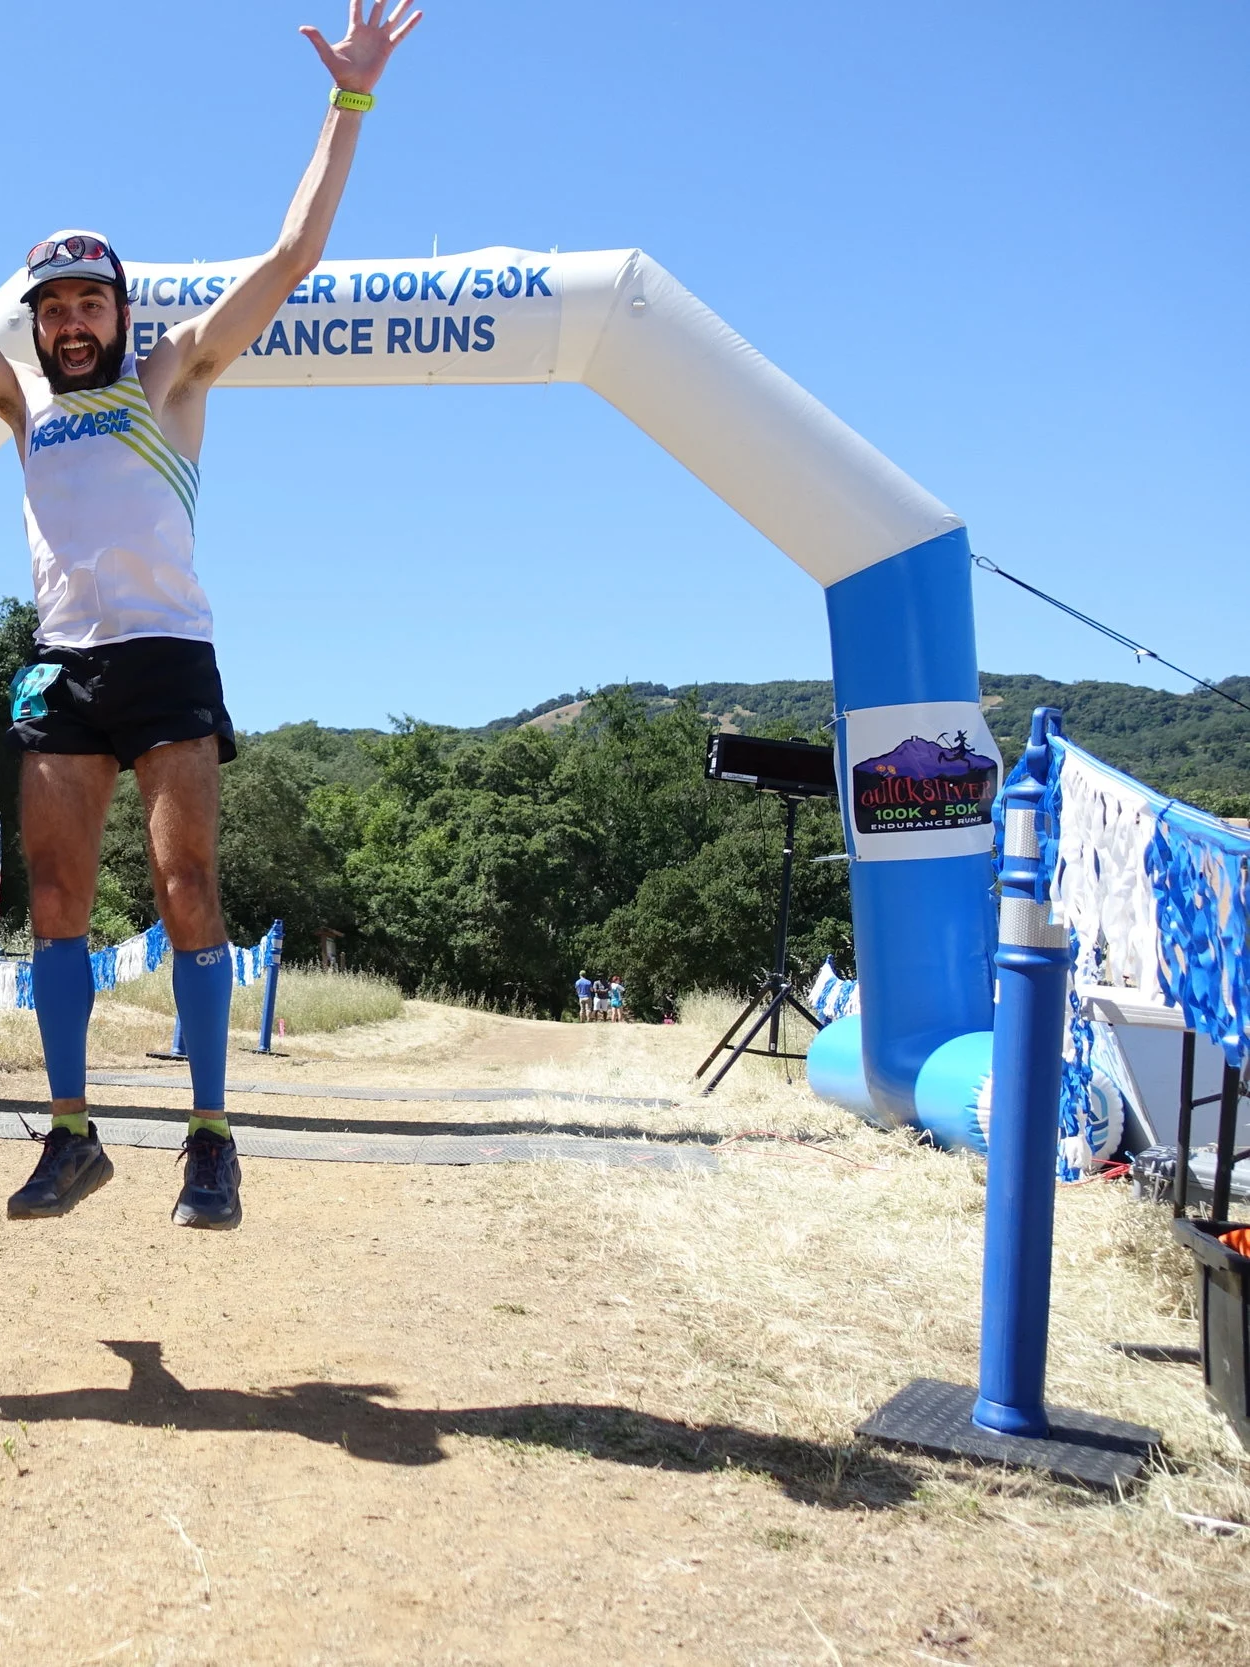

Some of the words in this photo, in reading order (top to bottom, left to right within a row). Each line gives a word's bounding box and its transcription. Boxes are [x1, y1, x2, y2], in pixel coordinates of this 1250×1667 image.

[350, 266, 553, 306] 100K/50K
[387, 315, 495, 354] RUNS
[29, 412, 96, 457] HOKA
[95, 408, 129, 424] ONE
[97, 420, 131, 435] ONE
[871, 819, 952, 831] ENDURANCE
[957, 815, 983, 825] RUNS
[875, 806, 922, 821] 100K
[944, 802, 979, 817] 50K
